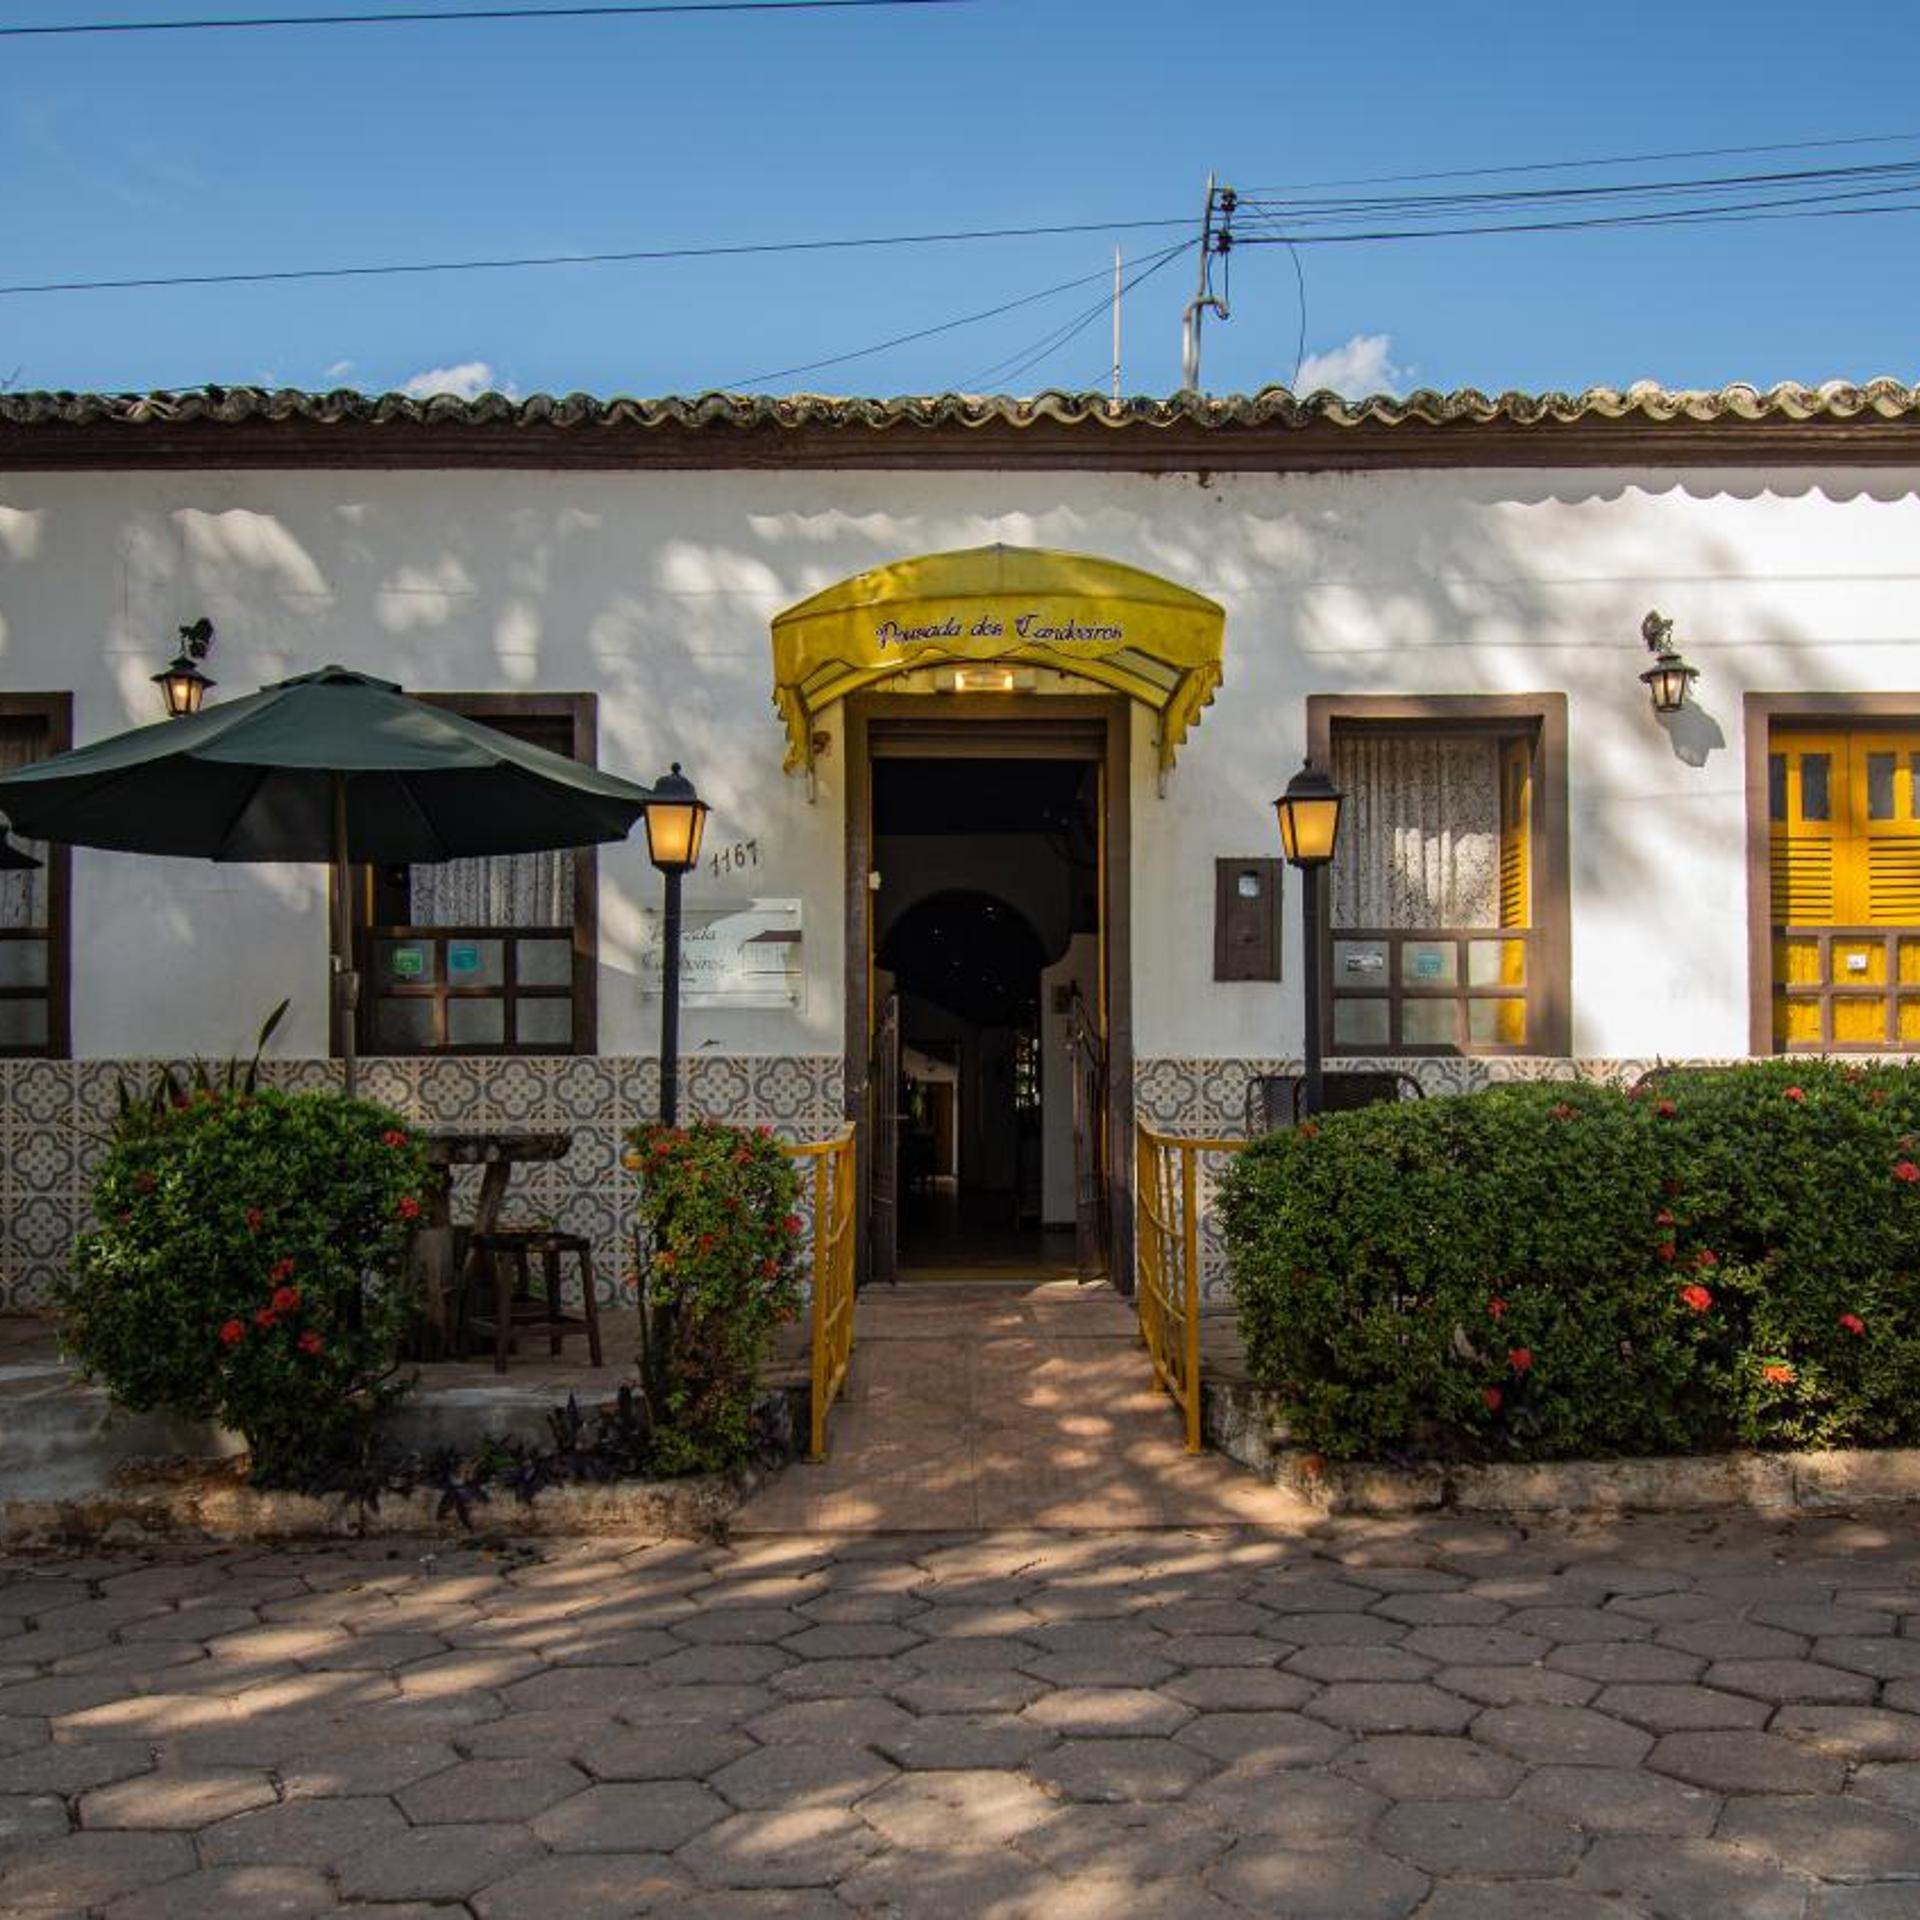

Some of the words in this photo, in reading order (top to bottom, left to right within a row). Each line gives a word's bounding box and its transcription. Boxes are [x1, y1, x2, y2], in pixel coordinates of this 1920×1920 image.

[875, 616, 962, 649] Pousada
[969, 615, 1003, 637] dos
[709, 838, 757, 878] 1167
